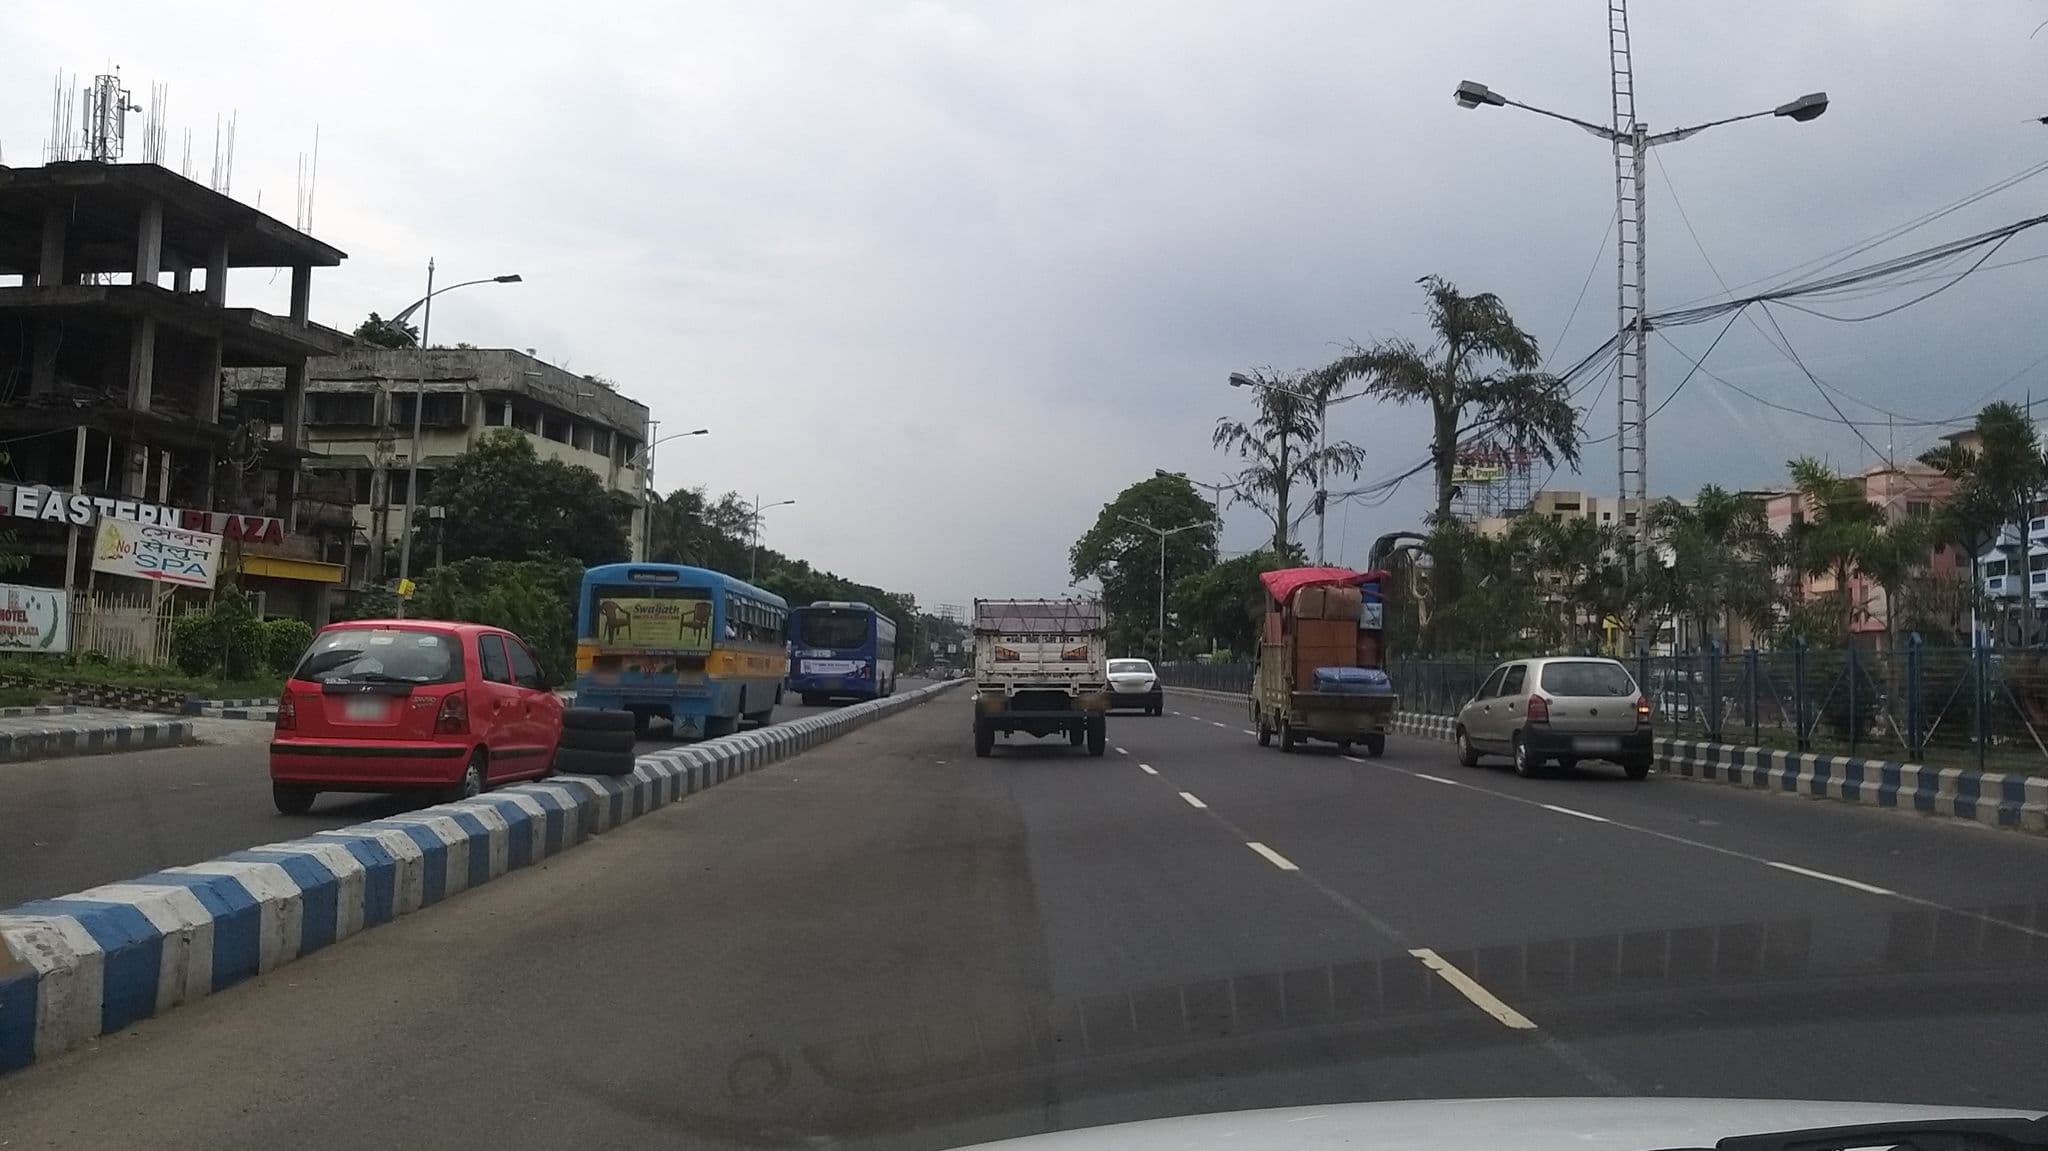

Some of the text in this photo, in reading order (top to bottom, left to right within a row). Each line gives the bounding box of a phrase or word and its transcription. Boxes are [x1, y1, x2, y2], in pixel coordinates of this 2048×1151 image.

[14, 485, 284, 545] EASTERN PLAZA
[135, 554, 207, 577] SPA
